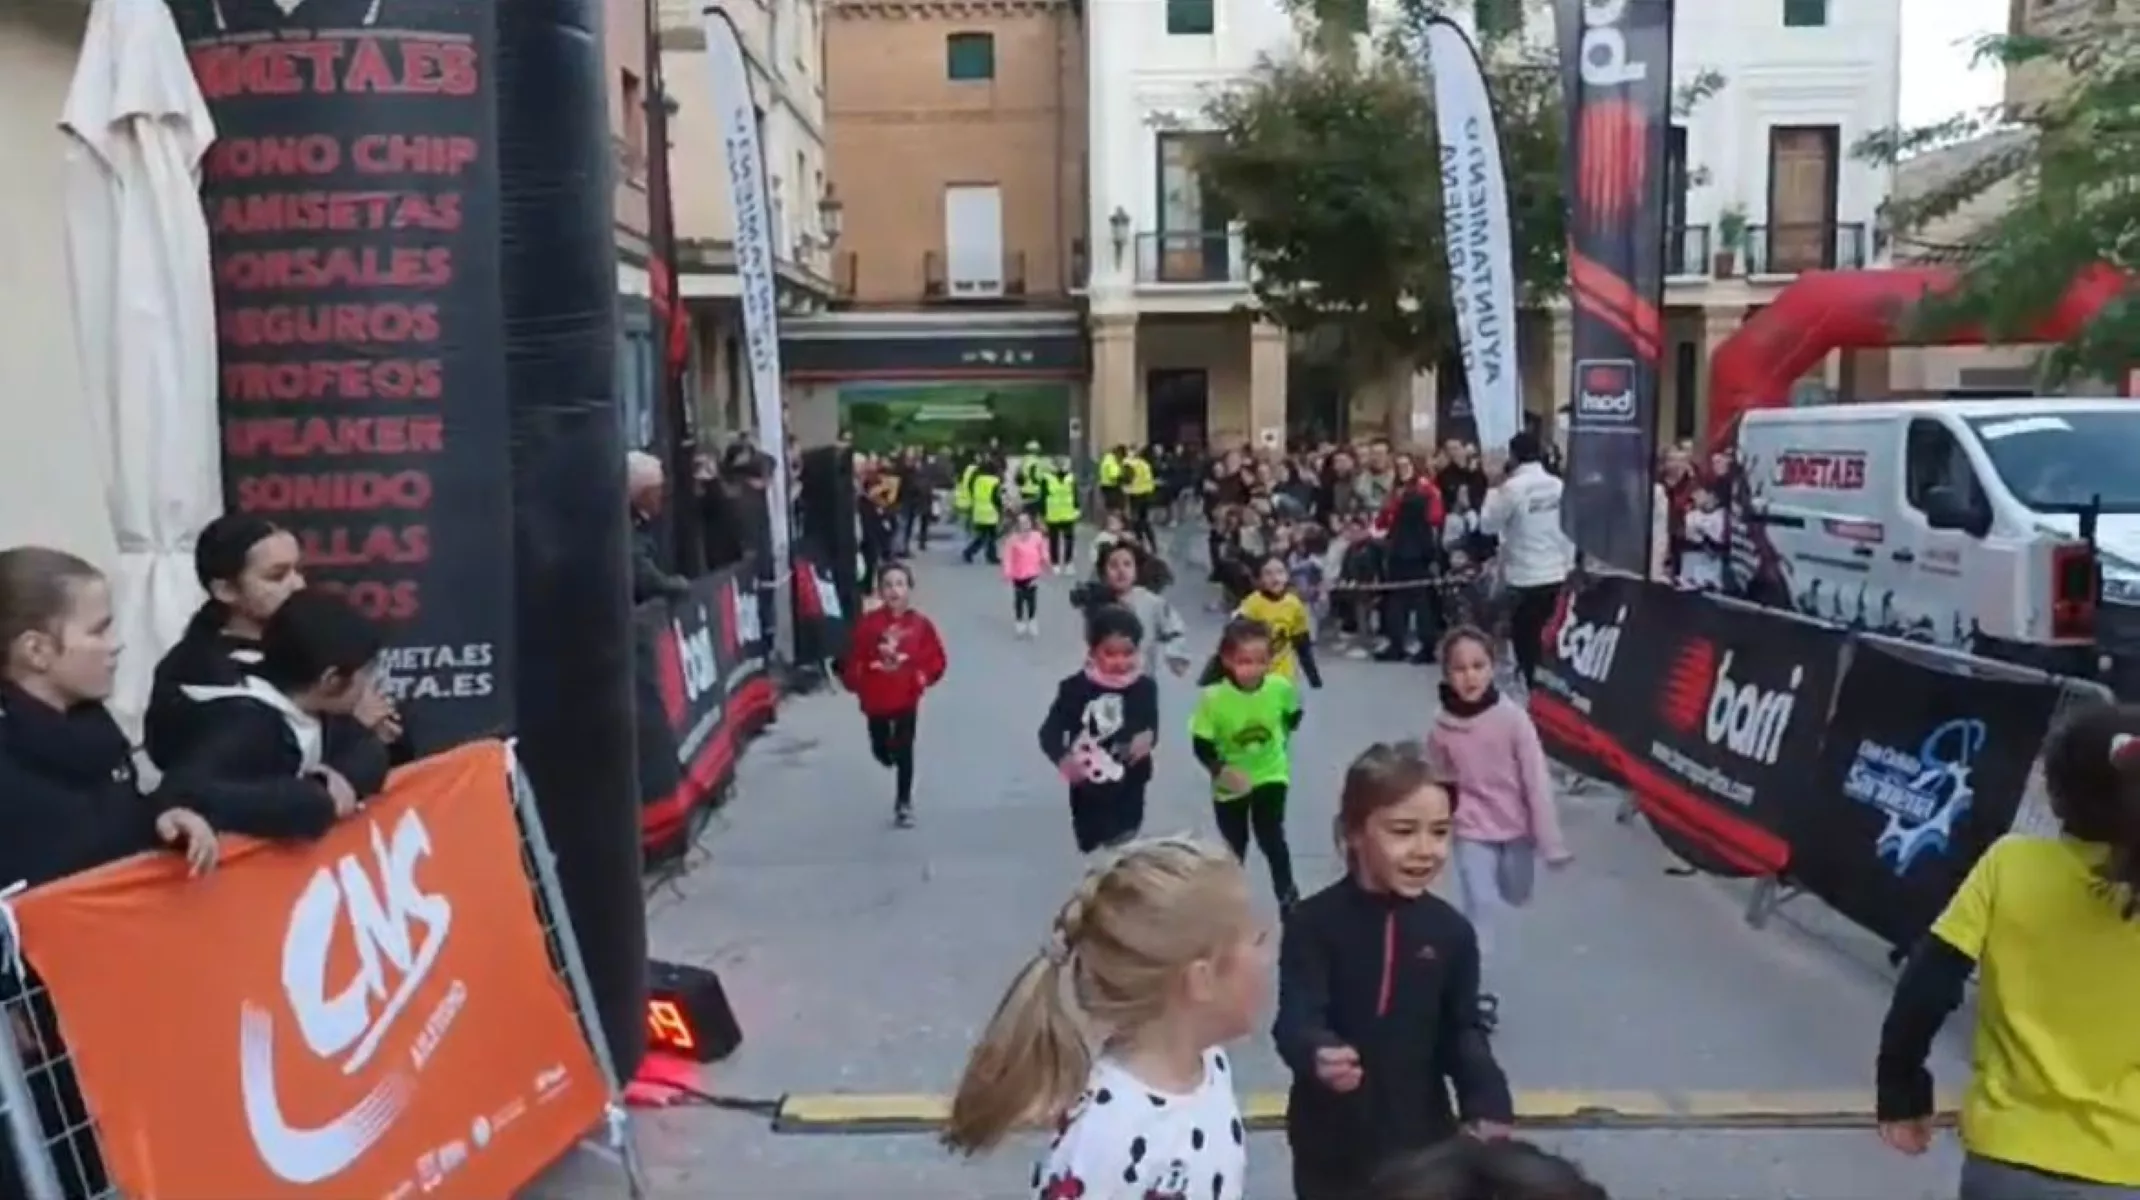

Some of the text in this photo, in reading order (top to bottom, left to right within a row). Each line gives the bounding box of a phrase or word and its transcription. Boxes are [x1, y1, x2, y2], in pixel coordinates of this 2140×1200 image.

[353, 134, 478, 175] CHIP
[215, 191, 463, 232] AMISETAS
[219, 246, 454, 289] ORSALES
[238, 469, 433, 512] SONIDO
[302, 524, 430, 566] LLAS
